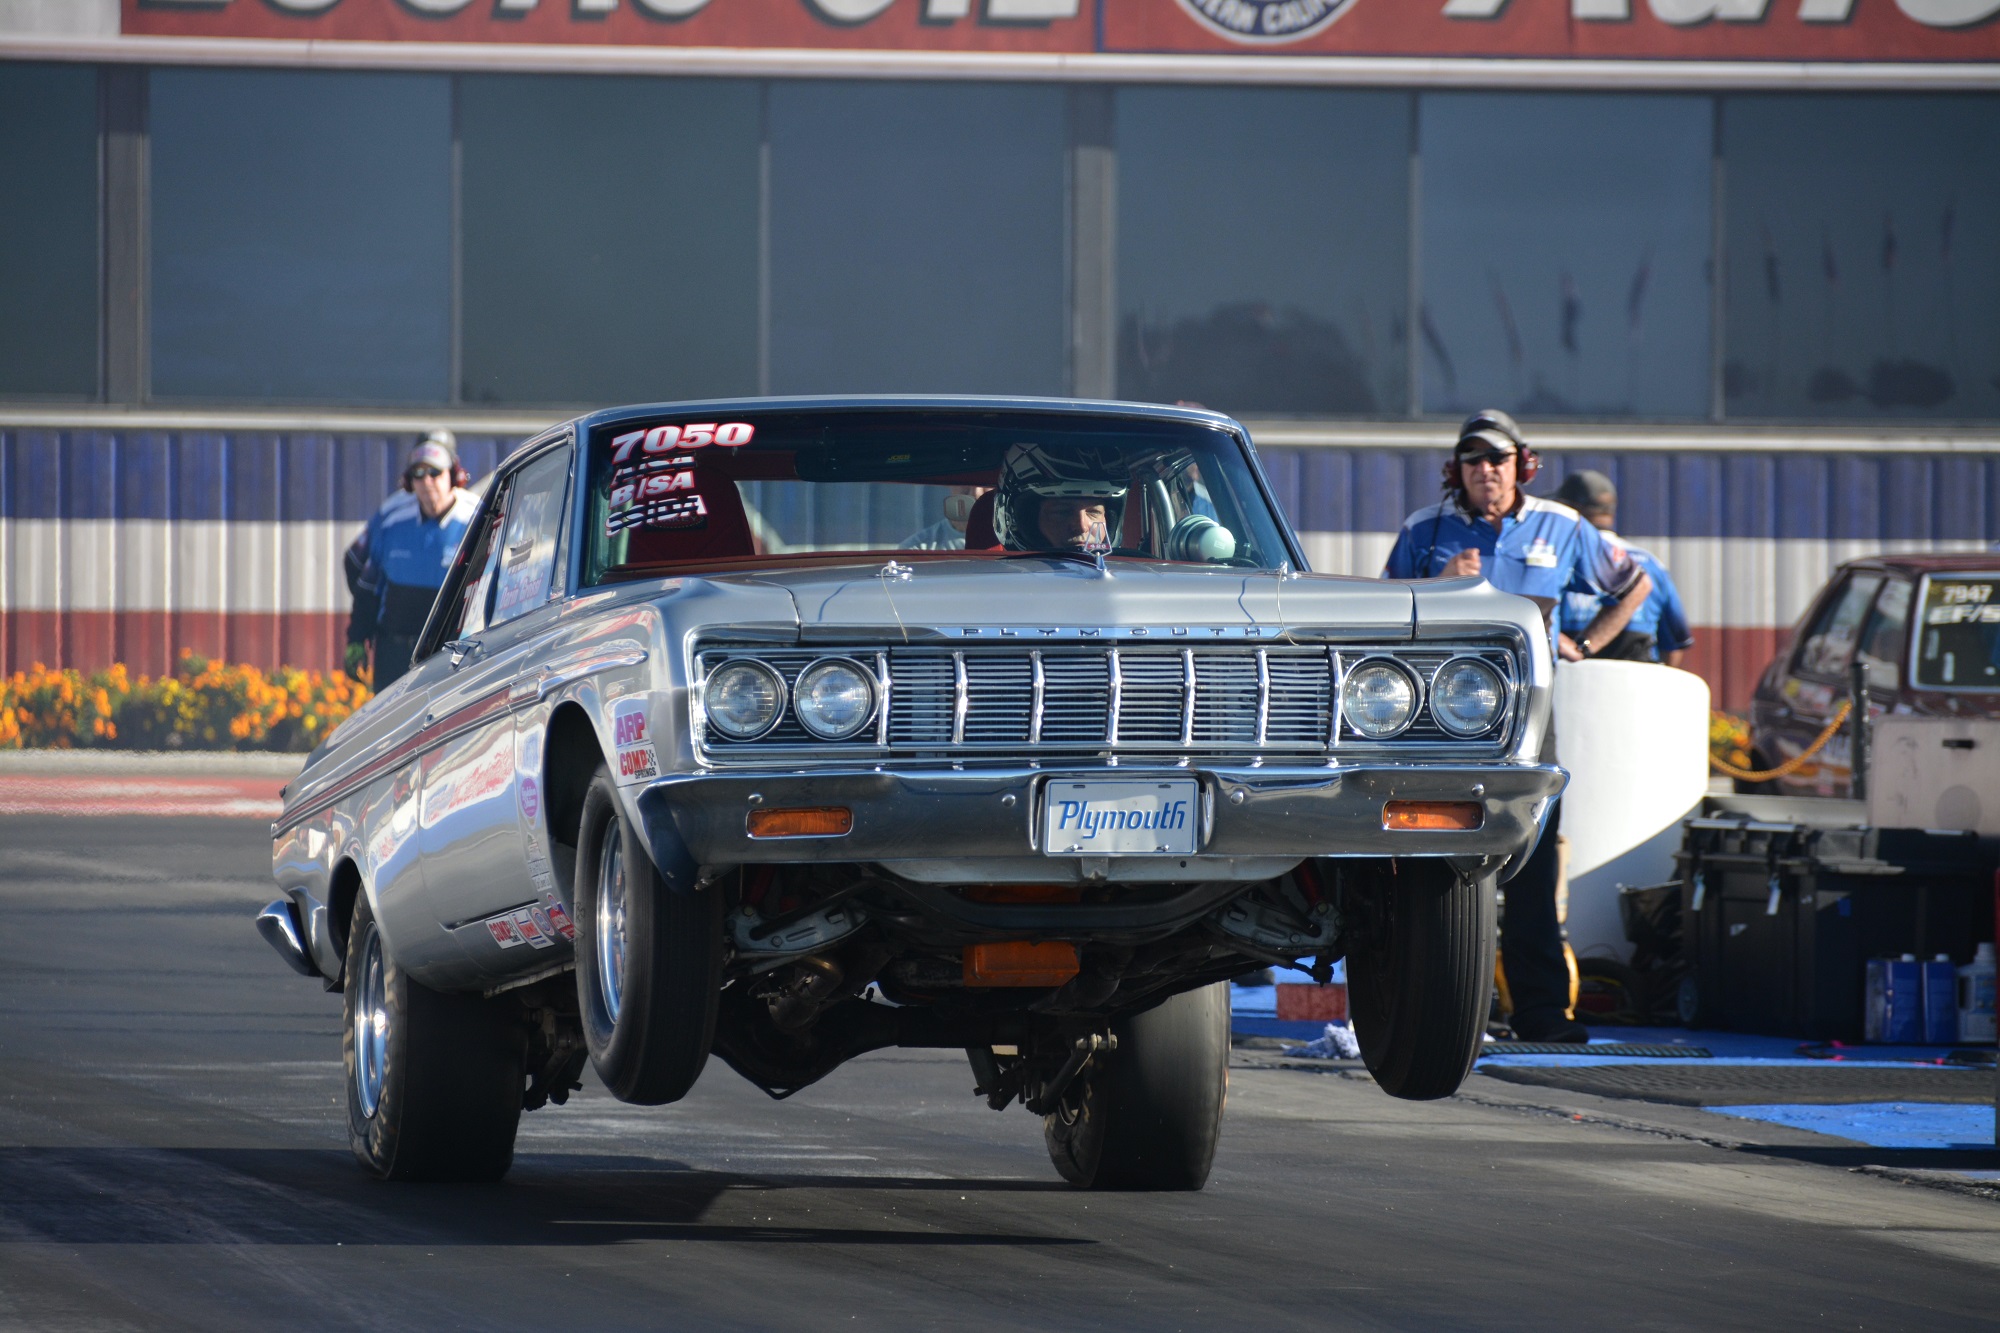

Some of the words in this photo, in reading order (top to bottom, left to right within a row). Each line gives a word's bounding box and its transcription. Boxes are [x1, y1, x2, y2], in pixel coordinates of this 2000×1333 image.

[611, 422, 755, 465] 7050
[609, 471, 696, 509] B/SA
[1943, 585, 1993, 604] 7947
[961, 627, 1262, 637] PLYMOUTH
[616, 712, 646, 745] ARP
[620, 749, 648, 776] COMP
[1058, 801, 1187, 839] Plymouth
